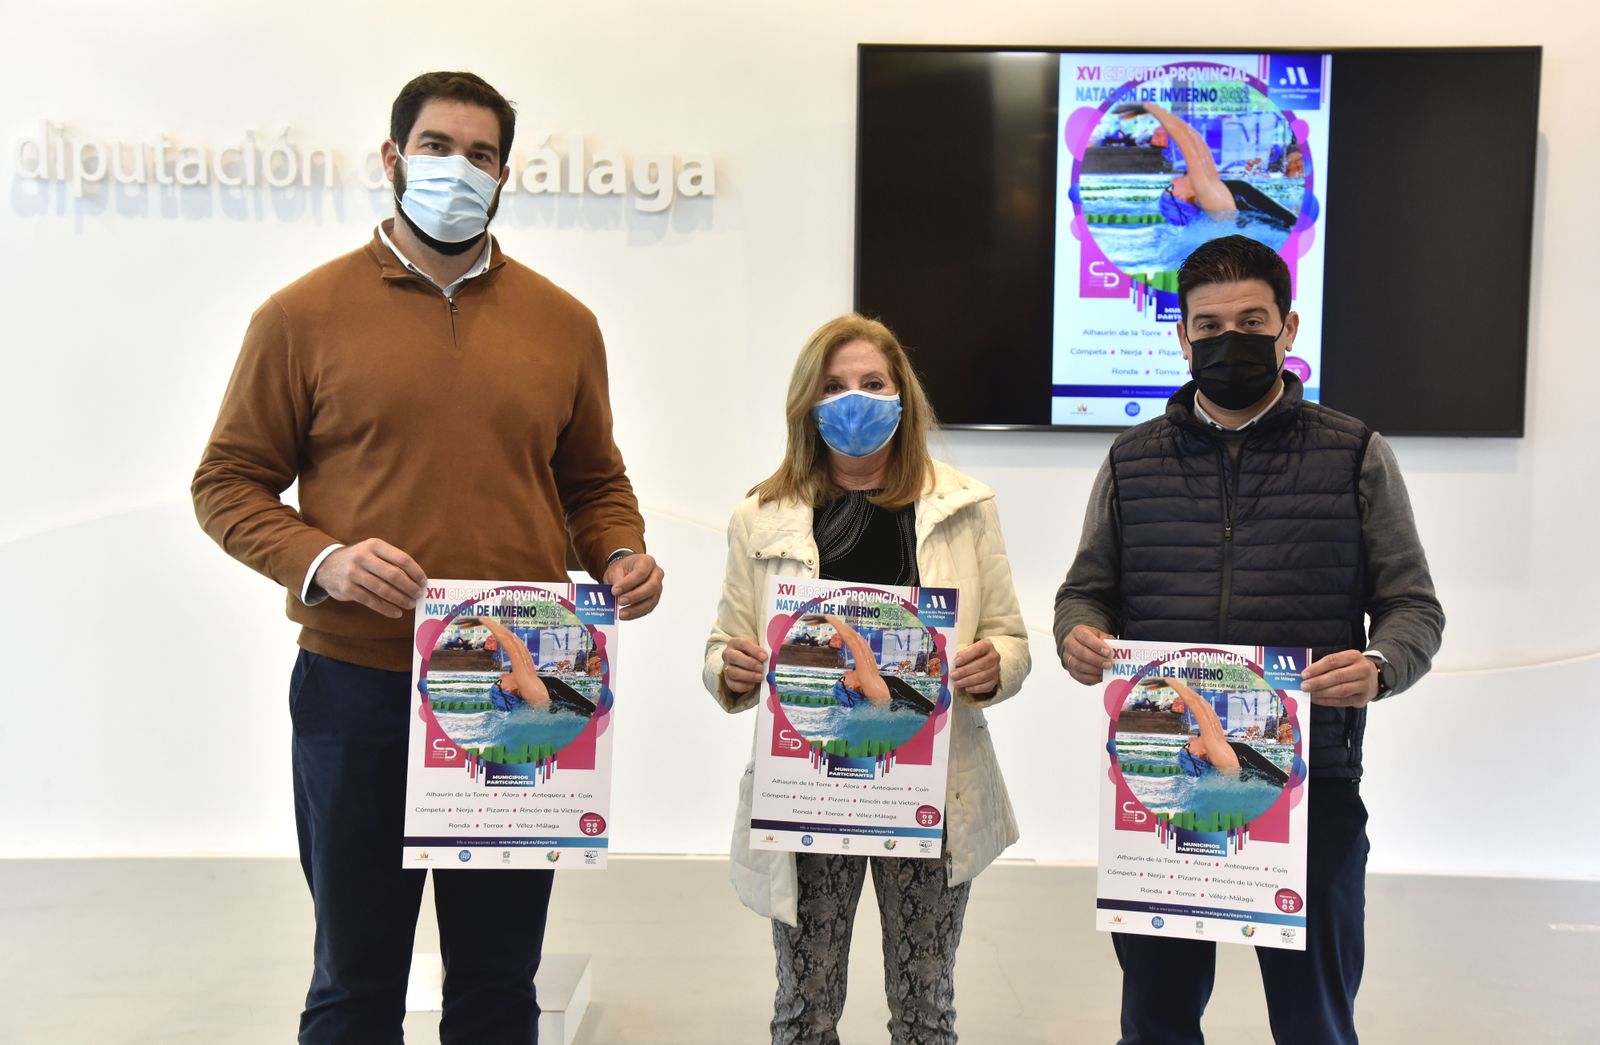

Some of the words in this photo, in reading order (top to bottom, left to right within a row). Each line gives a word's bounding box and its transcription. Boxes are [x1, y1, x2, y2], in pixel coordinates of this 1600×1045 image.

[1077, 66, 1100, 81] XVI
[1104, 66, 1165, 82] CIRCUITO
[1170, 67, 1250, 82] PROVINCIAL
[1141, 88, 1156, 101] DE
[1160, 88, 1217, 102] INVIERNO
[15, 118, 336, 198] diputación
[506, 134, 715, 212] álaga
[1070, 348, 1107, 356] Cómpeta
[426, 588, 446, 599] XVI
[449, 588, 495, 600] CIRCUITO
[500, 589, 561, 601] PROVINCIAL
[778, 584, 796, 596] XVI
[797, 585, 842, 599] CIRCUITO
[845, 590, 904, 605] PROVINCIAL
[425, 603, 473, 617] NATACIÓN
[477, 605, 489, 616] DE
[492, 605, 537, 618] INVIERNO
[776, 598, 821, 614] NATACIÓN
[823, 603, 835, 615] DE
[838, 605, 880, 619] INVIERNO
[1113, 648, 1131, 660] XVI
[1133, 649, 1181, 662] CIRCUITO
[1185, 651, 1248, 666] PROVINCIAL
[1113, 663, 1160, 678] NATACIÓN
[1163, 666, 1175, 678] DE
[1178, 667, 1223, 681] INVIERNO
[828, 771, 874, 779] PARTICIPANTES
[762, 792, 790, 800] Cómpeta
[856, 812, 897, 820] Vélez-Málaga
[1177, 847, 1226, 855] PARTICIPANTES
[1193, 859, 1211, 867] Álora
[1224, 862, 1259, 871] Antequera
[1107, 869, 1137, 878] Cómpeta
[1148, 872, 1165, 880] Nerja
[1178, 874, 1201, 882] Pizarra
[1212, 877, 1235, 885] Rincón
[1209, 893, 1253, 903] Vélez-Málaga
